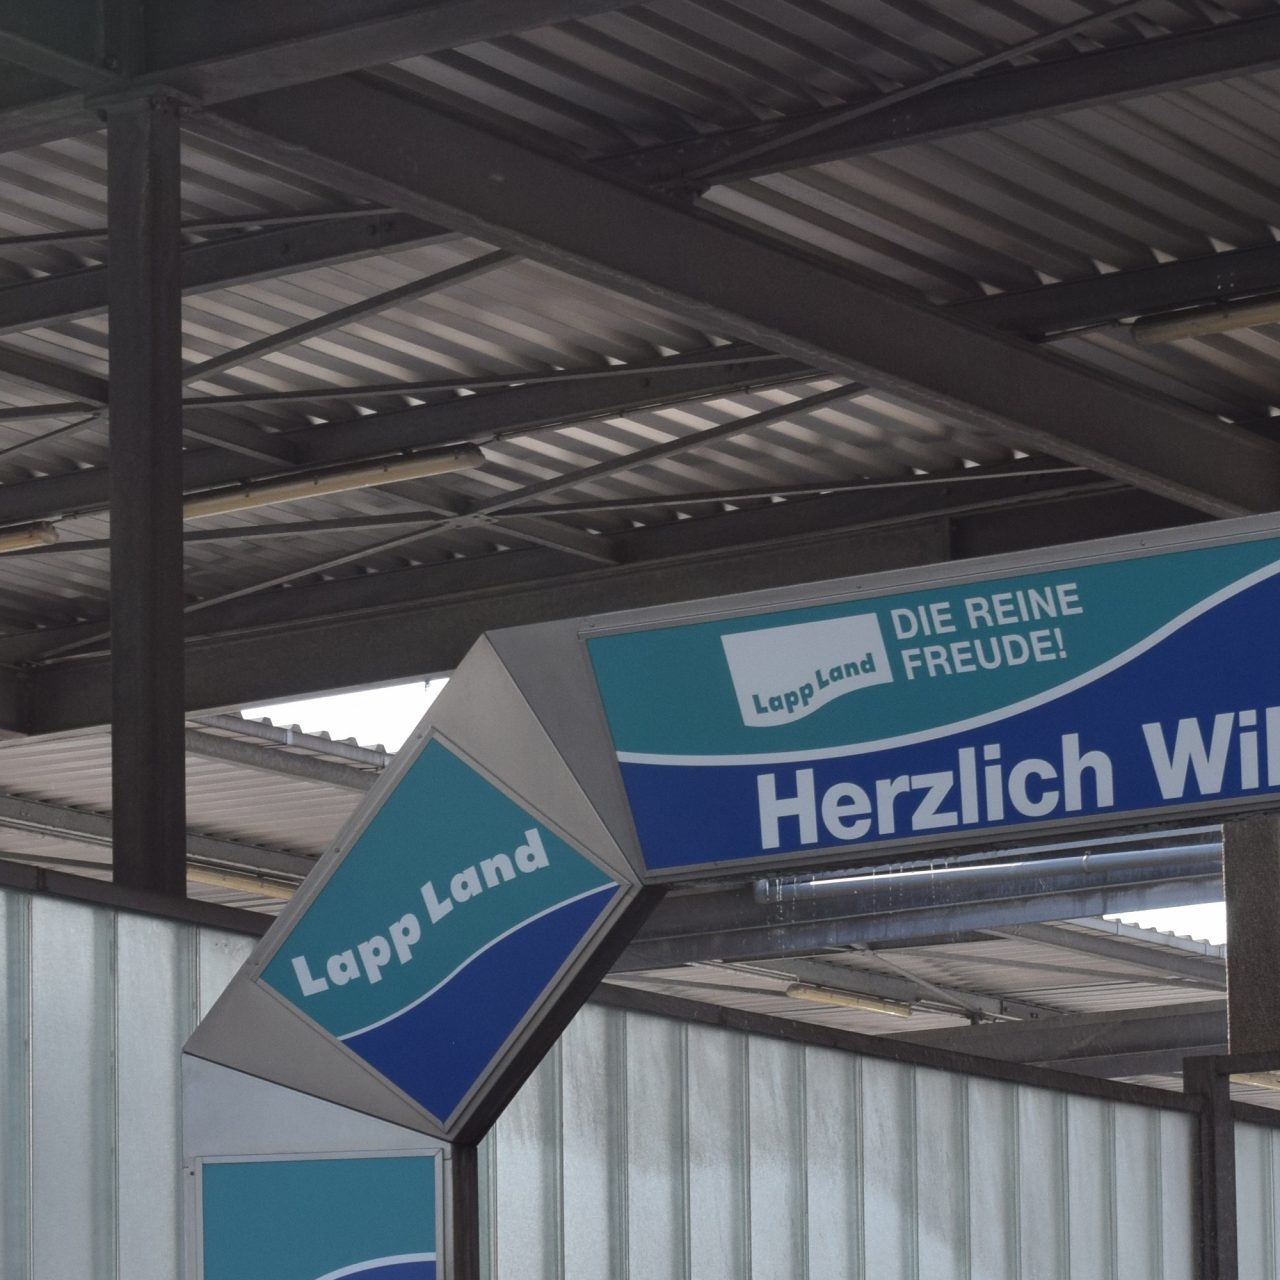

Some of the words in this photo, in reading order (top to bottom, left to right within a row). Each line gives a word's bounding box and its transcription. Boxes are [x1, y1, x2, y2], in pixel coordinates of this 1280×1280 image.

[890, 601, 957, 640] DIE
[964, 582, 1084, 630] REINE
[900, 627, 1067, 680] FREUDE!
[756, 732, 1114, 850] Herzlich
